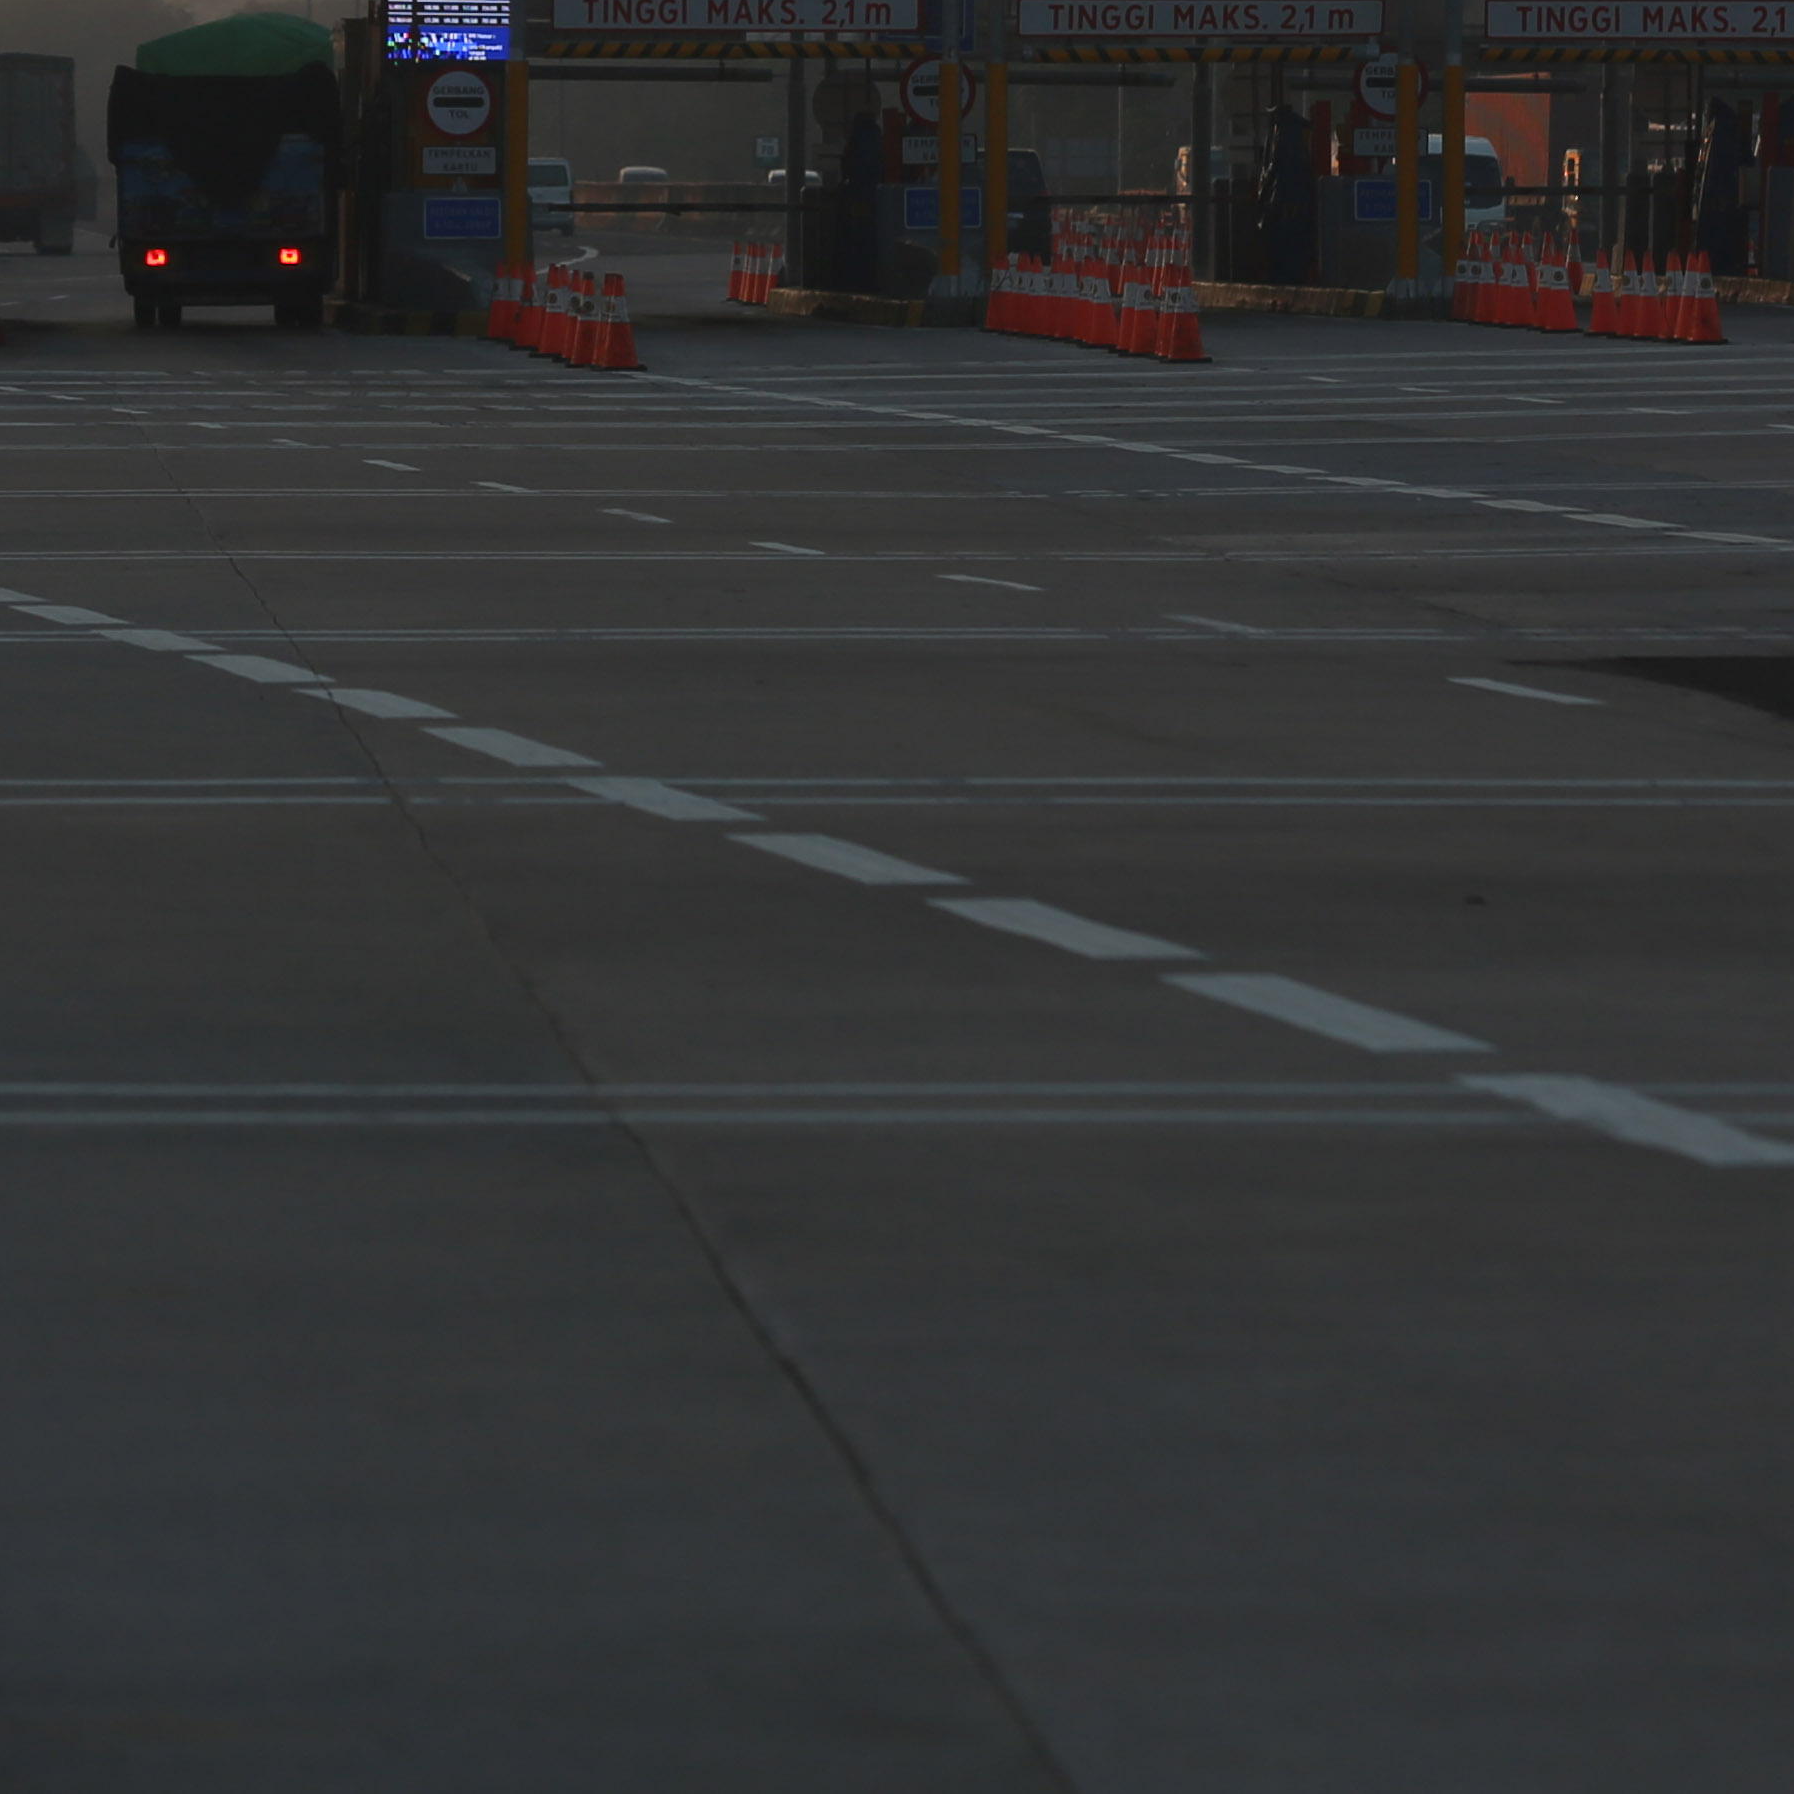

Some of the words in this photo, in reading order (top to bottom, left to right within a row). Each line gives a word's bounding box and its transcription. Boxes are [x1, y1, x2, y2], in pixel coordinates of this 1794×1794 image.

[1049, 4, 1153, 30] TINGGI
[1174, 5, 1268, 30] MAKS.
[1516, 6, 1620, 33] TINGGI
[1643, 6, 1736, 32] MAKS.
